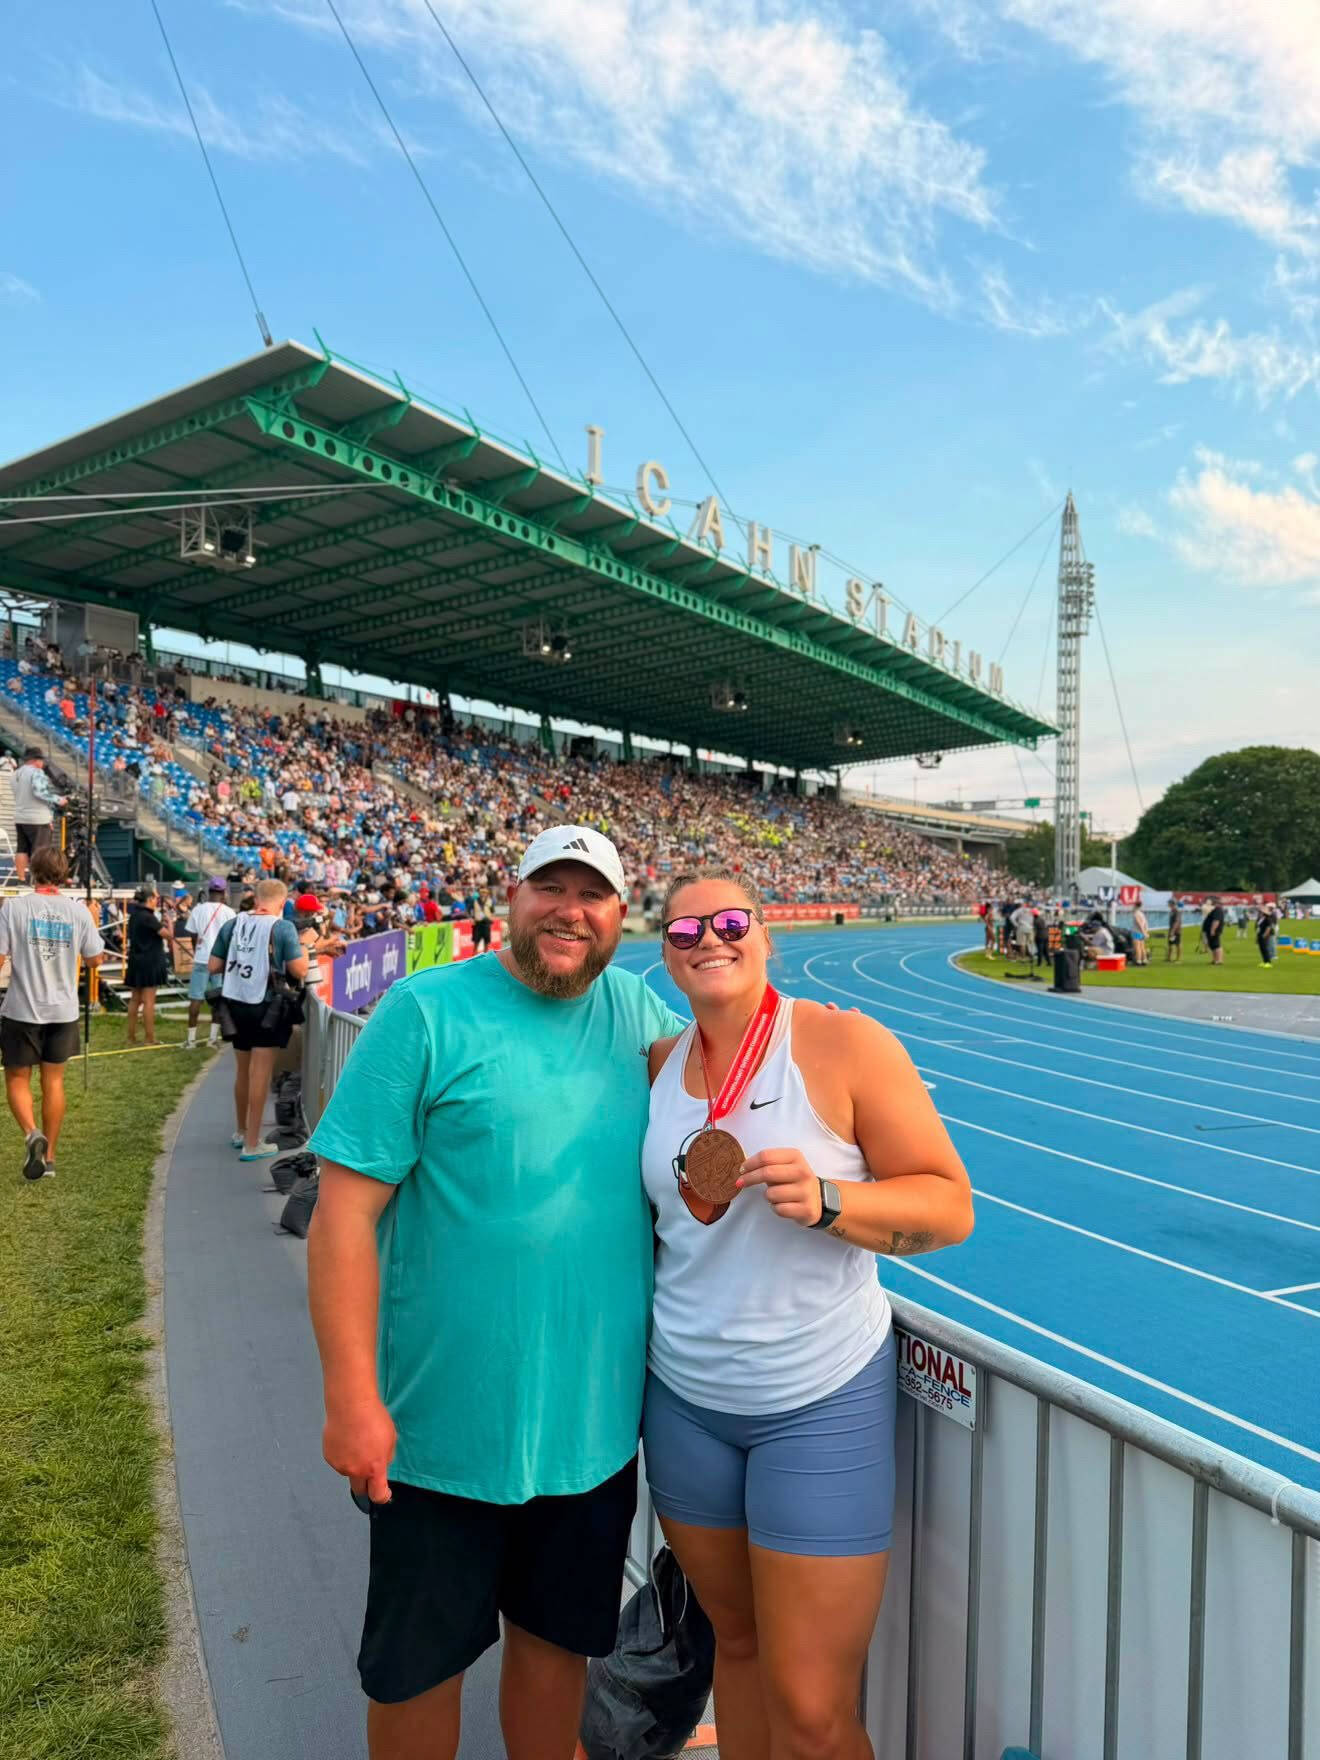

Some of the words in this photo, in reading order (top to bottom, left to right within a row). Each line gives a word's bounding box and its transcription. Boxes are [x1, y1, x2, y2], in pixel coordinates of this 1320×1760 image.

[585, 424, 817, 593] ICAHN
[845, 578, 1004, 695] STADIUM
[345, 953, 373, 1001] xfinity
